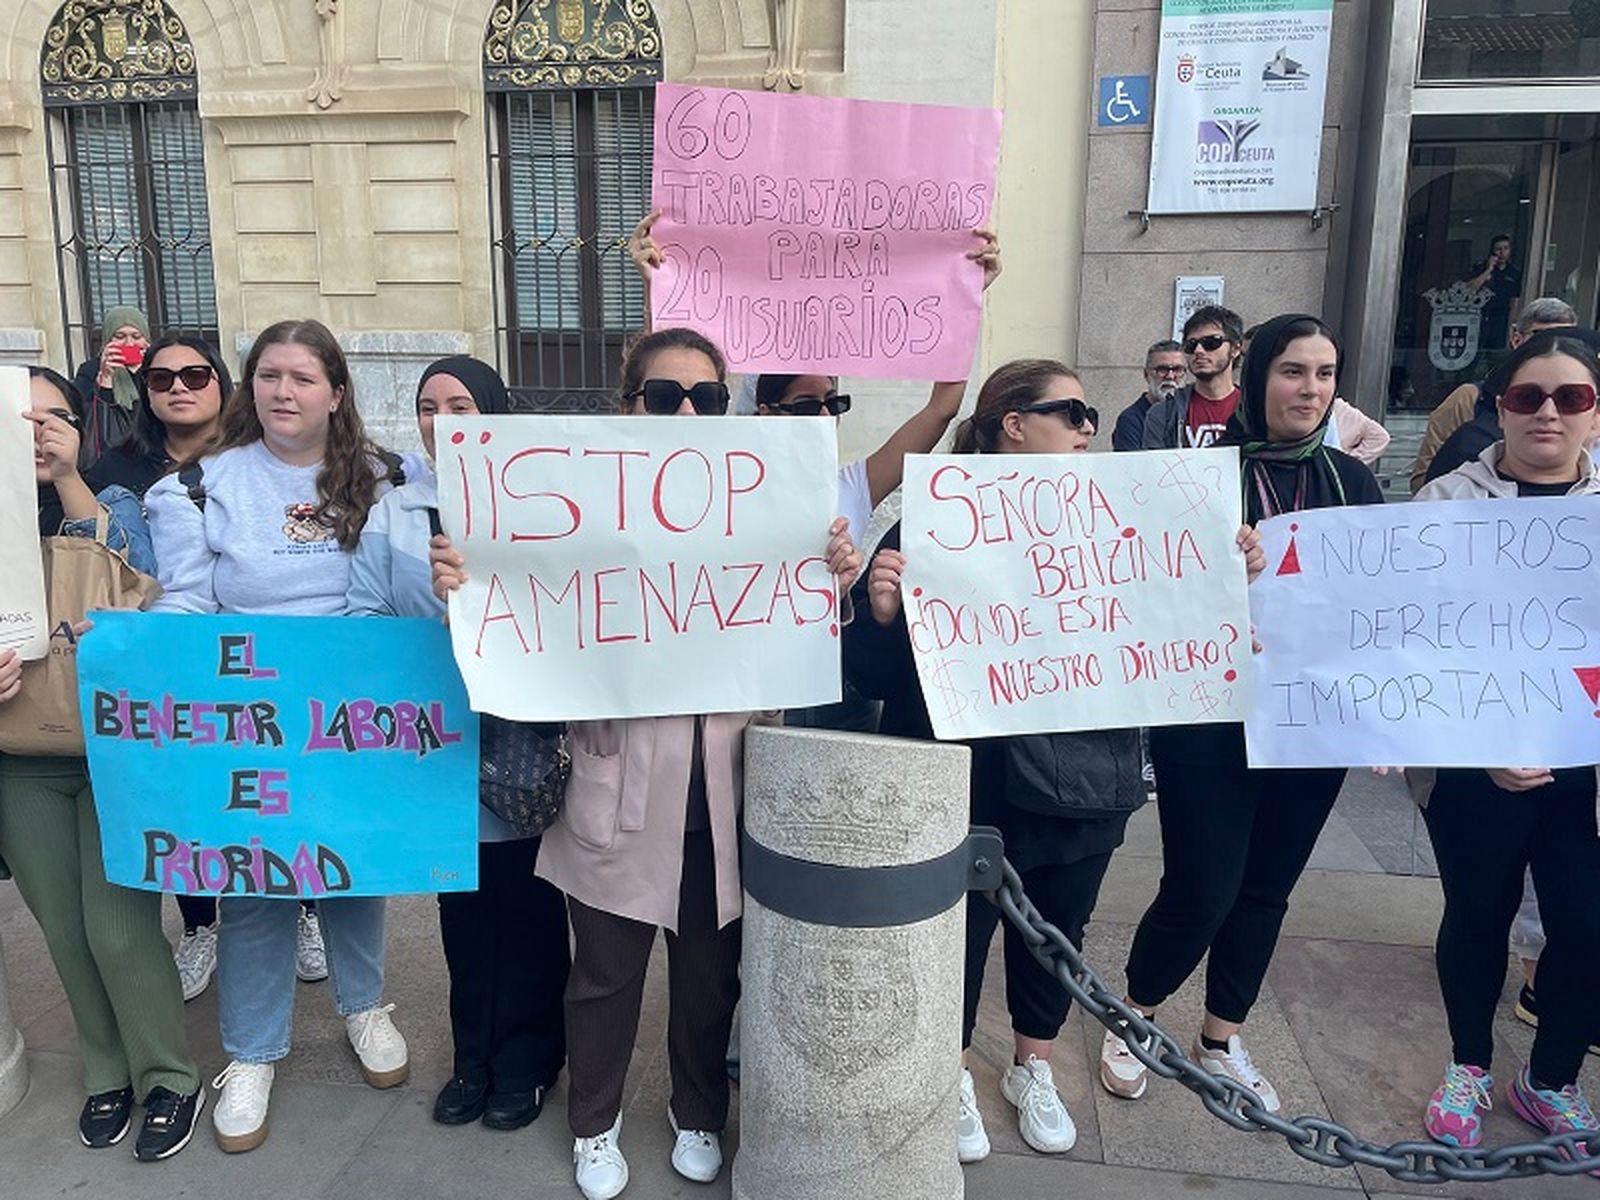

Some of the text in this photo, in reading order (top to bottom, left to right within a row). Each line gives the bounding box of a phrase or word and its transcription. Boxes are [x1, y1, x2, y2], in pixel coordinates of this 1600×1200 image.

[1205, 67, 1241, 79] Ceuta
[665, 89, 751, 160] 60
[1198, 142, 1275, 163] COP CEUTA
[661, 169, 987, 231] TRABAJADORAS
[767, 229, 889, 281] PARA
[655, 243, 723, 322] 20
[927, 464, 1120, 551] SEÑORA
[1057, 594, 1133, 633] ESTA
[1350, 596, 1589, 651] DERECHOS
[217, 634, 279, 680] EL
[987, 652, 1104, 705] NUESTRO
[94, 689, 463, 759] BIENESTAR LABORAL
[223, 768, 289, 817] ES
